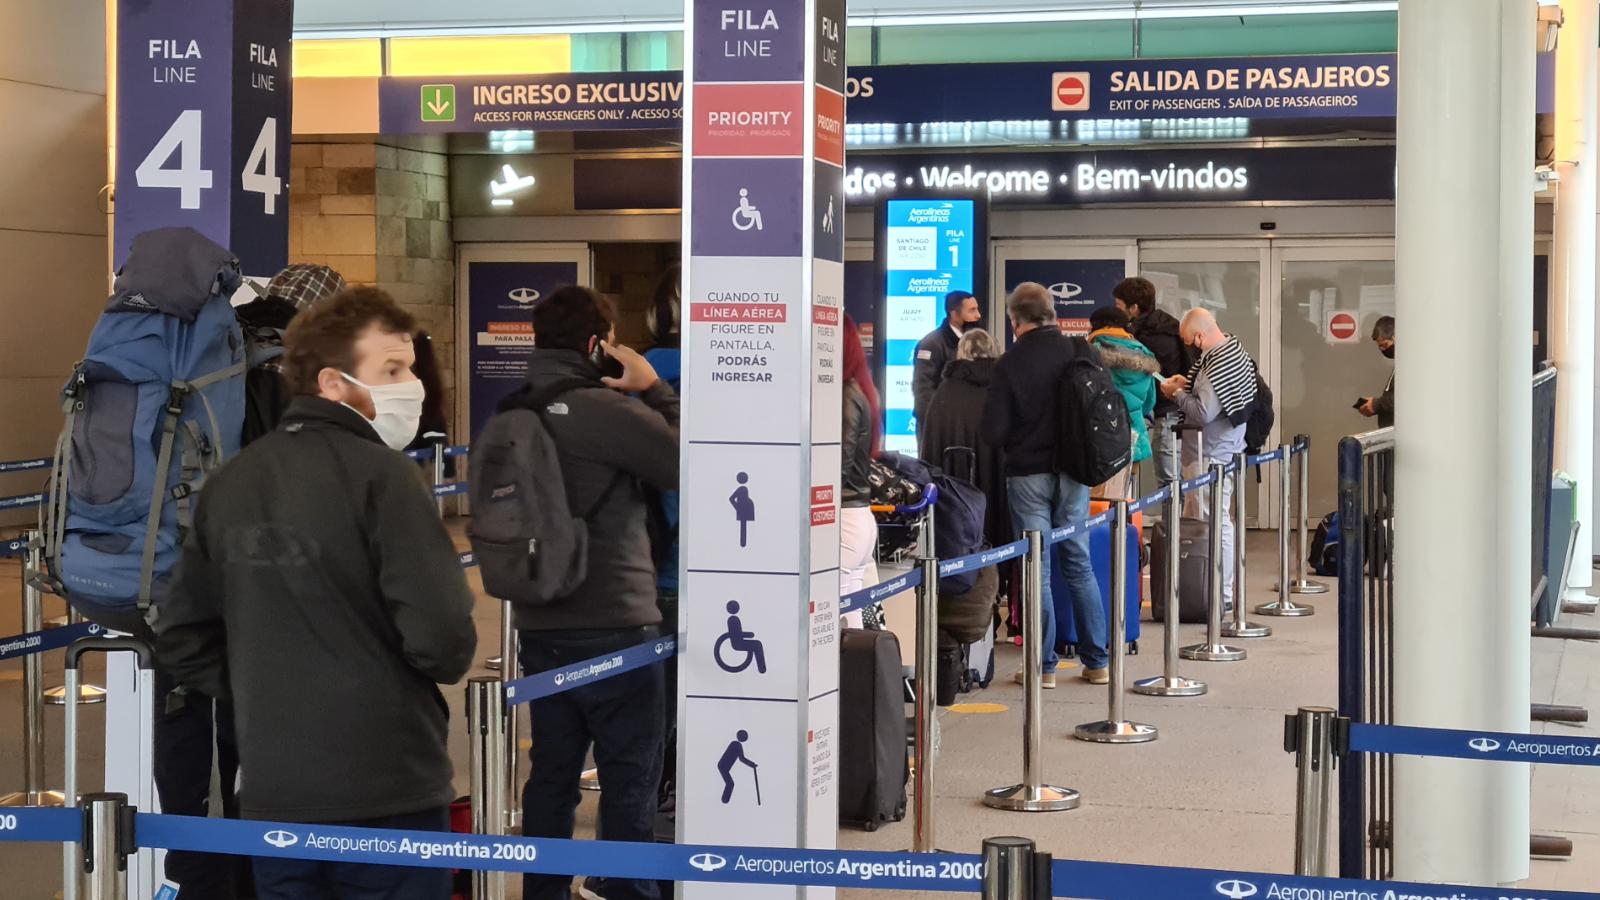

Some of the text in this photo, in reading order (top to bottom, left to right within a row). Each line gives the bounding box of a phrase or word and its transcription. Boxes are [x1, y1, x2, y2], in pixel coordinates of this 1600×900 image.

[721, 9, 779, 30] FILA
[822, 16, 839, 43] FILA
[149, 39, 202, 59] FILA
[250, 43, 278, 68] FILA
[724, 40, 772, 57] LINE
[823, 46, 837, 66] LINE
[153, 67, 196, 83] LINE
[252, 72, 275, 91] LINE
[1110, 65, 1390, 92] SALIDA DE PASAJEROS
[473, 81, 682, 105] INGRESO EXCLUSIV
[1109, 95, 1358, 111] EXIT OF PASSENGERS SAÍDA DE PASSAGEIROS
[474, 111, 509, 122] ACCESS
[512, 110, 532, 121] FOR
[534, 109, 596, 121] PASSENGERS
[597, 108, 625, 120] ONLY
[631, 108, 670, 118] ACESSO
[708, 111, 792, 125] PRIORITY
[817, 113, 840, 133] PRIORITY
[135, 109, 213, 209] 4
[241, 117, 281, 215] 4
[920, 165, 1049, 193] Welcome
[1077, 161, 1248, 191] Bem-vindos
[949, 246, 958, 267] 1
[707, 292, 779, 302] CUANDO TU
[703, 306, 783, 319] LÍNEA AÉREA
[711, 324, 774, 334] FIGURE EN
[710, 340, 775, 351] PANTALLA,
[718, 353, 767, 366] PODRÁS
[711, 371, 772, 383] INGRESAR
[1507, 739, 1591, 757] Aeropuertos
[305, 832, 537, 861] Aeropuertos Argentina 2000
[734, 854, 834, 877] Aeropuertos
[836, 858, 936, 880] Argentina
